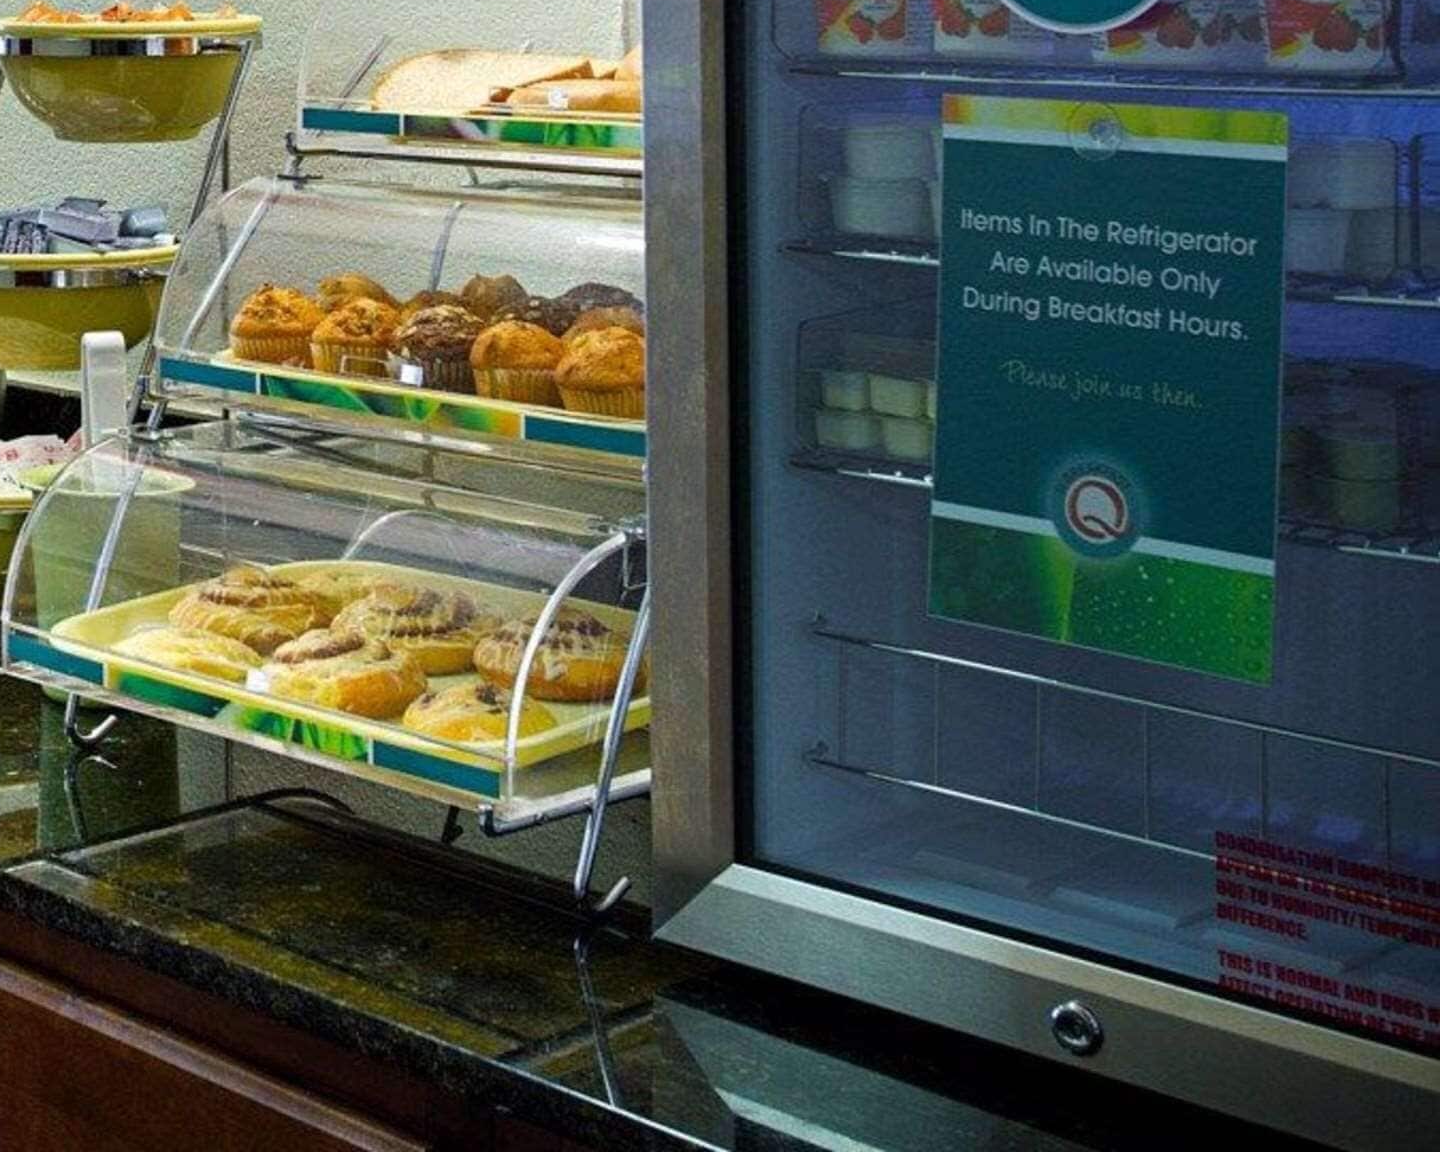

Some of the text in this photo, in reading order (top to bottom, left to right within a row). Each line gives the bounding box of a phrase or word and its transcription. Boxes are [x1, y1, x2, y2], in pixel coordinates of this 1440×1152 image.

[961, 208, 1257, 256] Items In The Refrigerator
[990, 250, 1222, 299] Are Available Only
[963, 286, 1249, 341] During Breakfast Hours.
[1000, 358, 1204, 409] Please join us then.
